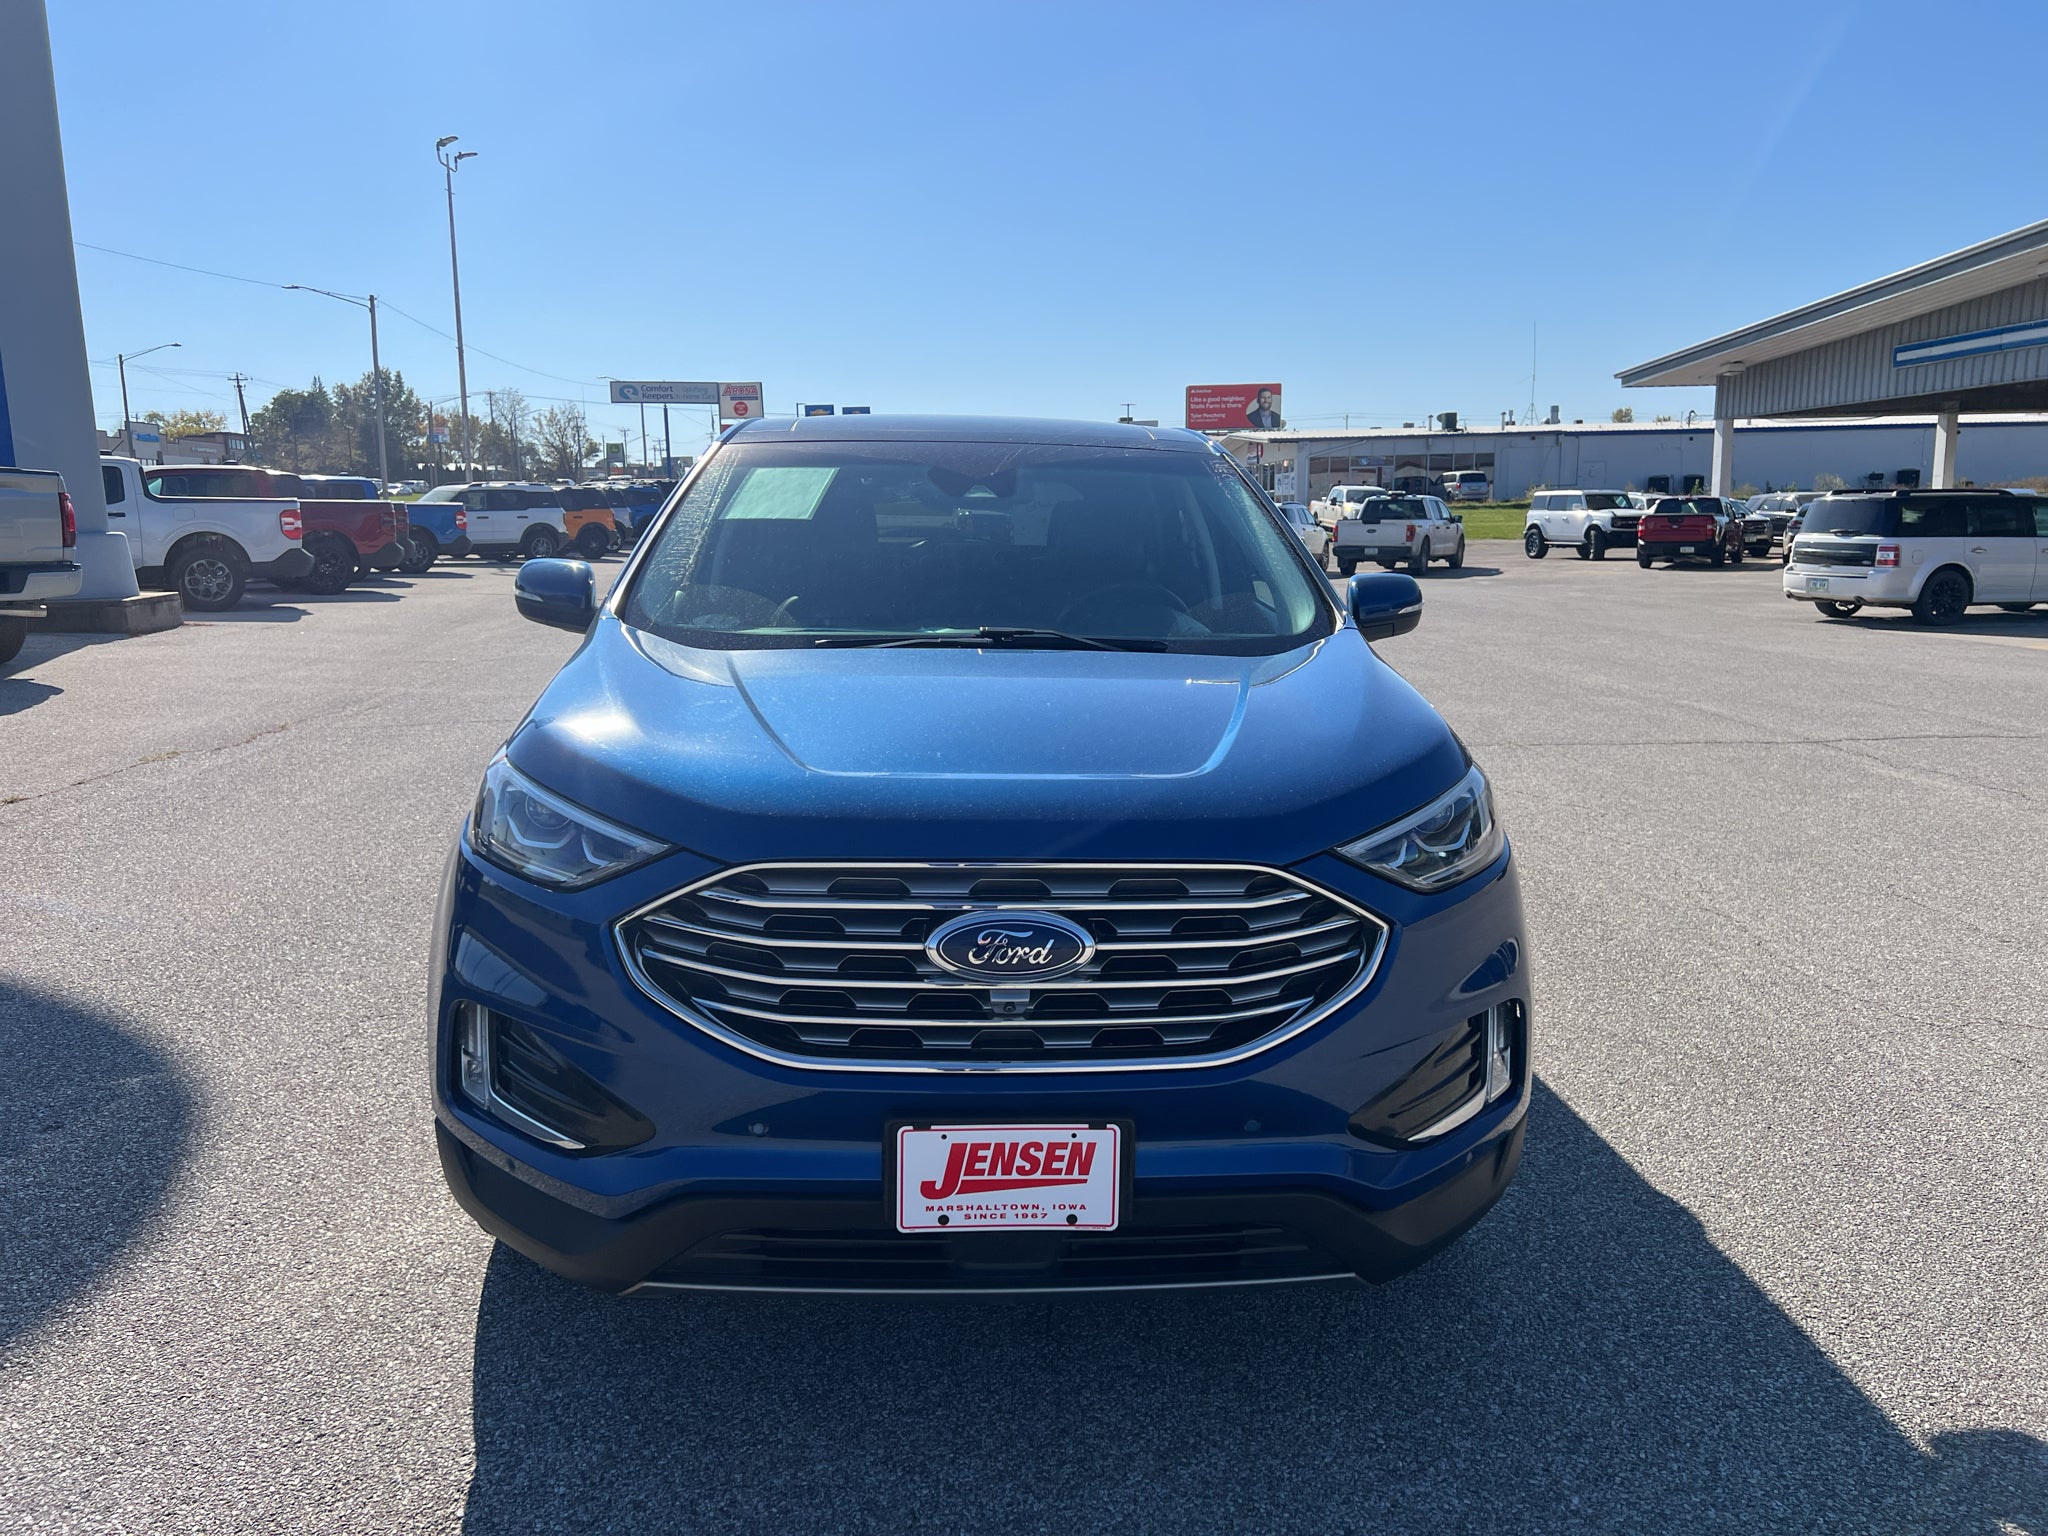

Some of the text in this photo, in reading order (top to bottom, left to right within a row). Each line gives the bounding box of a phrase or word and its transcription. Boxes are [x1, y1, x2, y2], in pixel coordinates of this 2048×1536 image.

[642, 392, 674, 400] Keepers
[968, 929, 1054, 964] Ford
[920, 1141, 1097, 1200] JENSEN
[925, 1203, 1087, 1212] MARSHALLTOWN, IOWA
